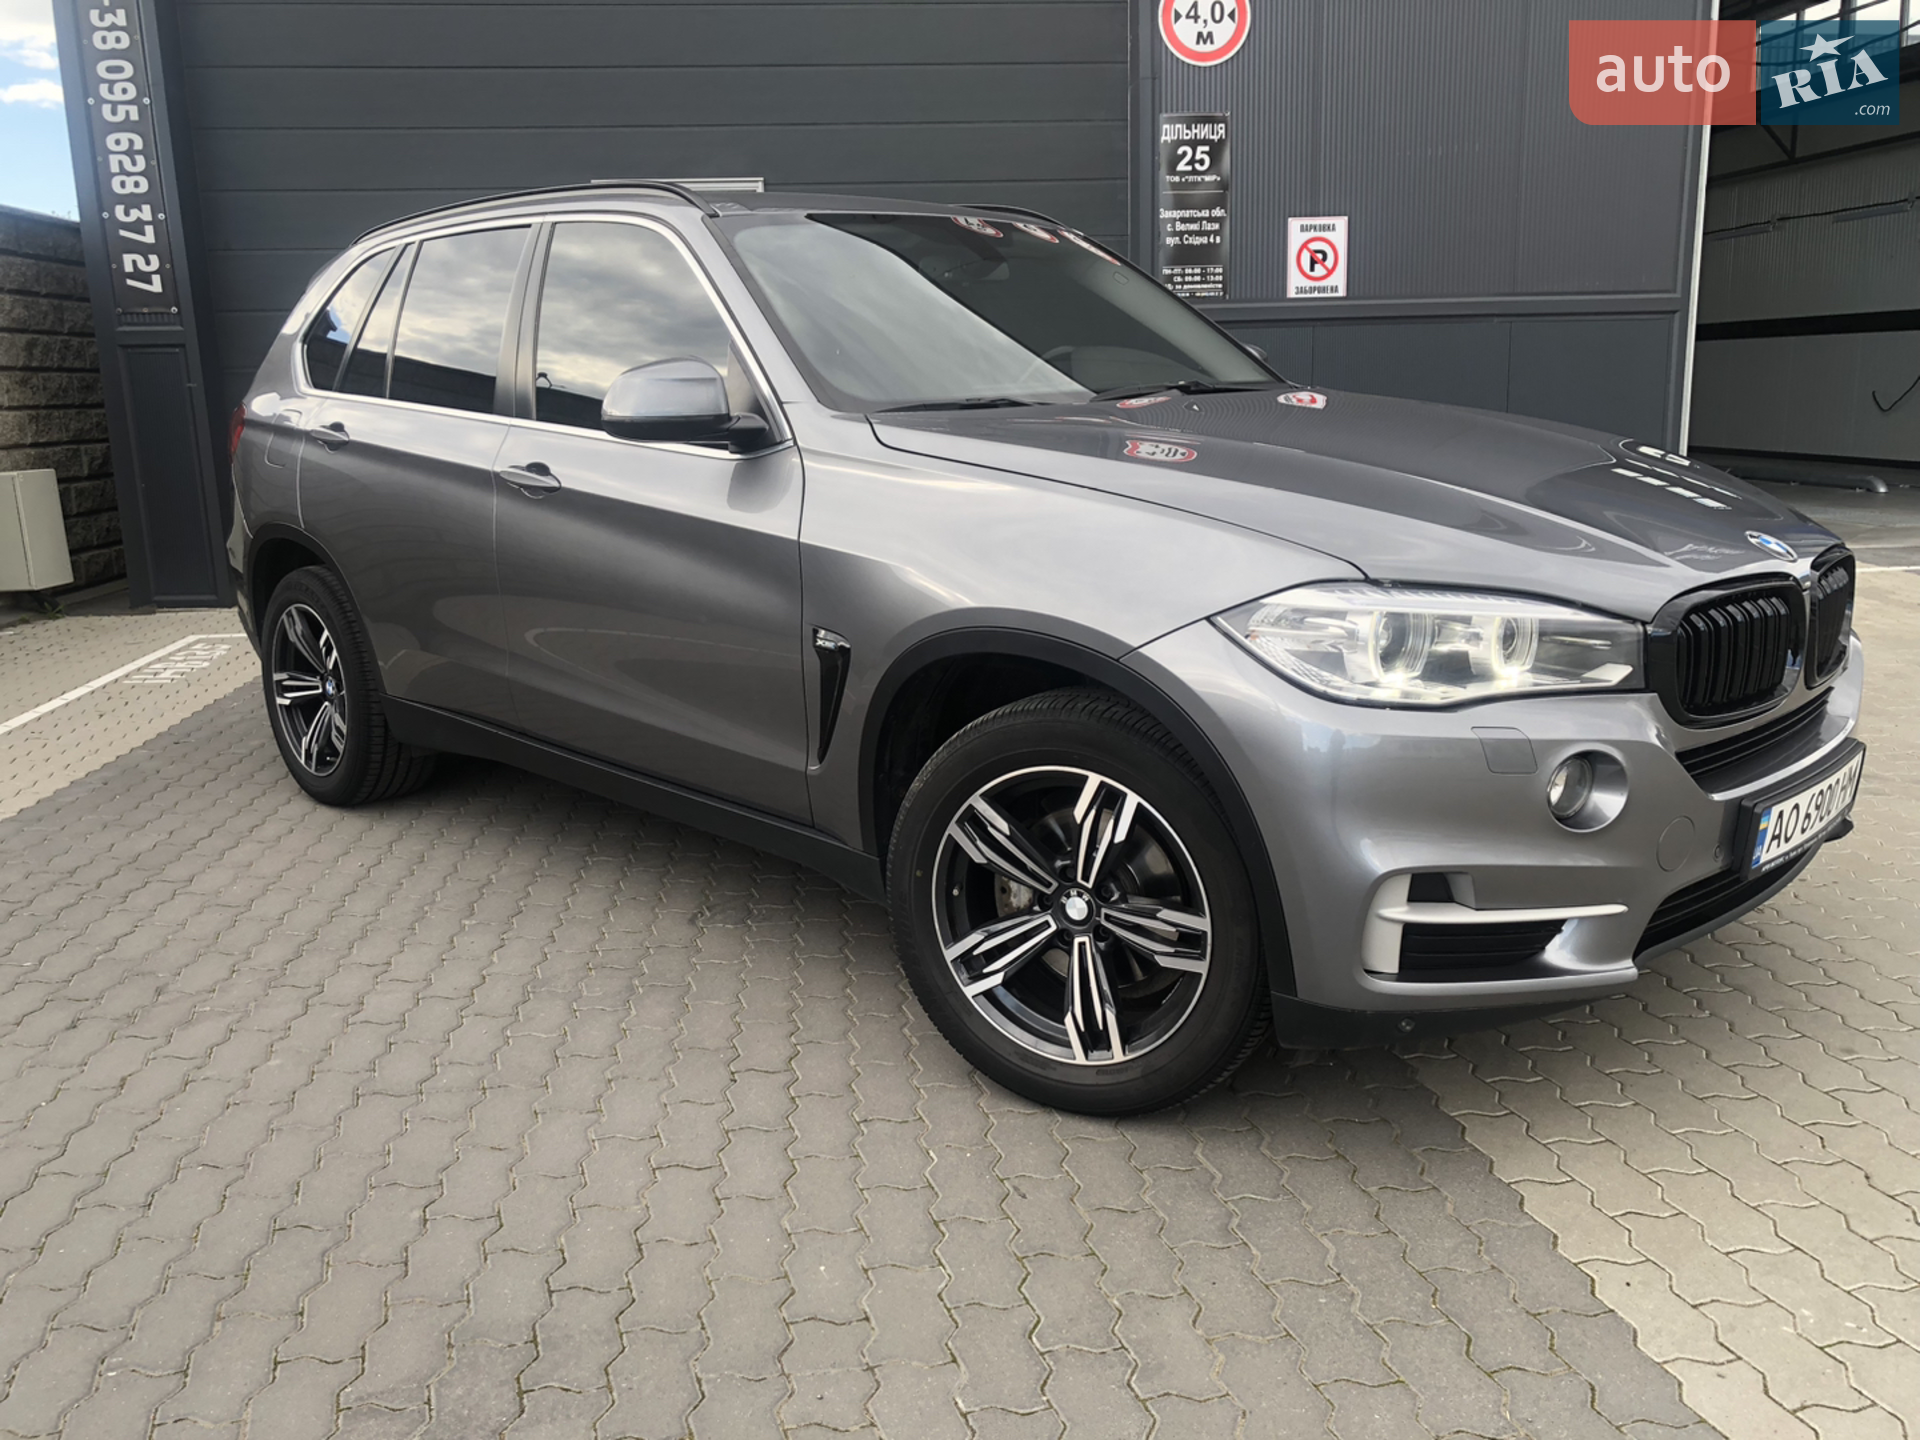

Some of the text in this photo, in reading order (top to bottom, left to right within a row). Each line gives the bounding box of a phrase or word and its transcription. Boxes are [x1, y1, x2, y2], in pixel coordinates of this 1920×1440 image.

[1185, 0, 1225, 28] 4,0
[96, 59, 139, 123] 095
[1161, 123, 1226, 143] ДІЛЬНИЦЯ
[105, 132, 149, 194] 628
[1176, 146, 1211, 172] 25
[114, 204, 156, 244] 37
[1159, 206, 1227, 219] Закарпатська обл.
[1175, 221, 1200, 231] Великі
[1201, 221, 1220, 230] Лази
[1299, 223, 1336, 233] ПАРКОВКА
[1165, 235, 1181, 247] вул.
[1209, 234, 1215, 243] 4
[122, 253, 163, 293] 27
[1294, 284, 1339, 295] ЗАБОРОНЕНА
[1766, 803, 1799, 853] AO
